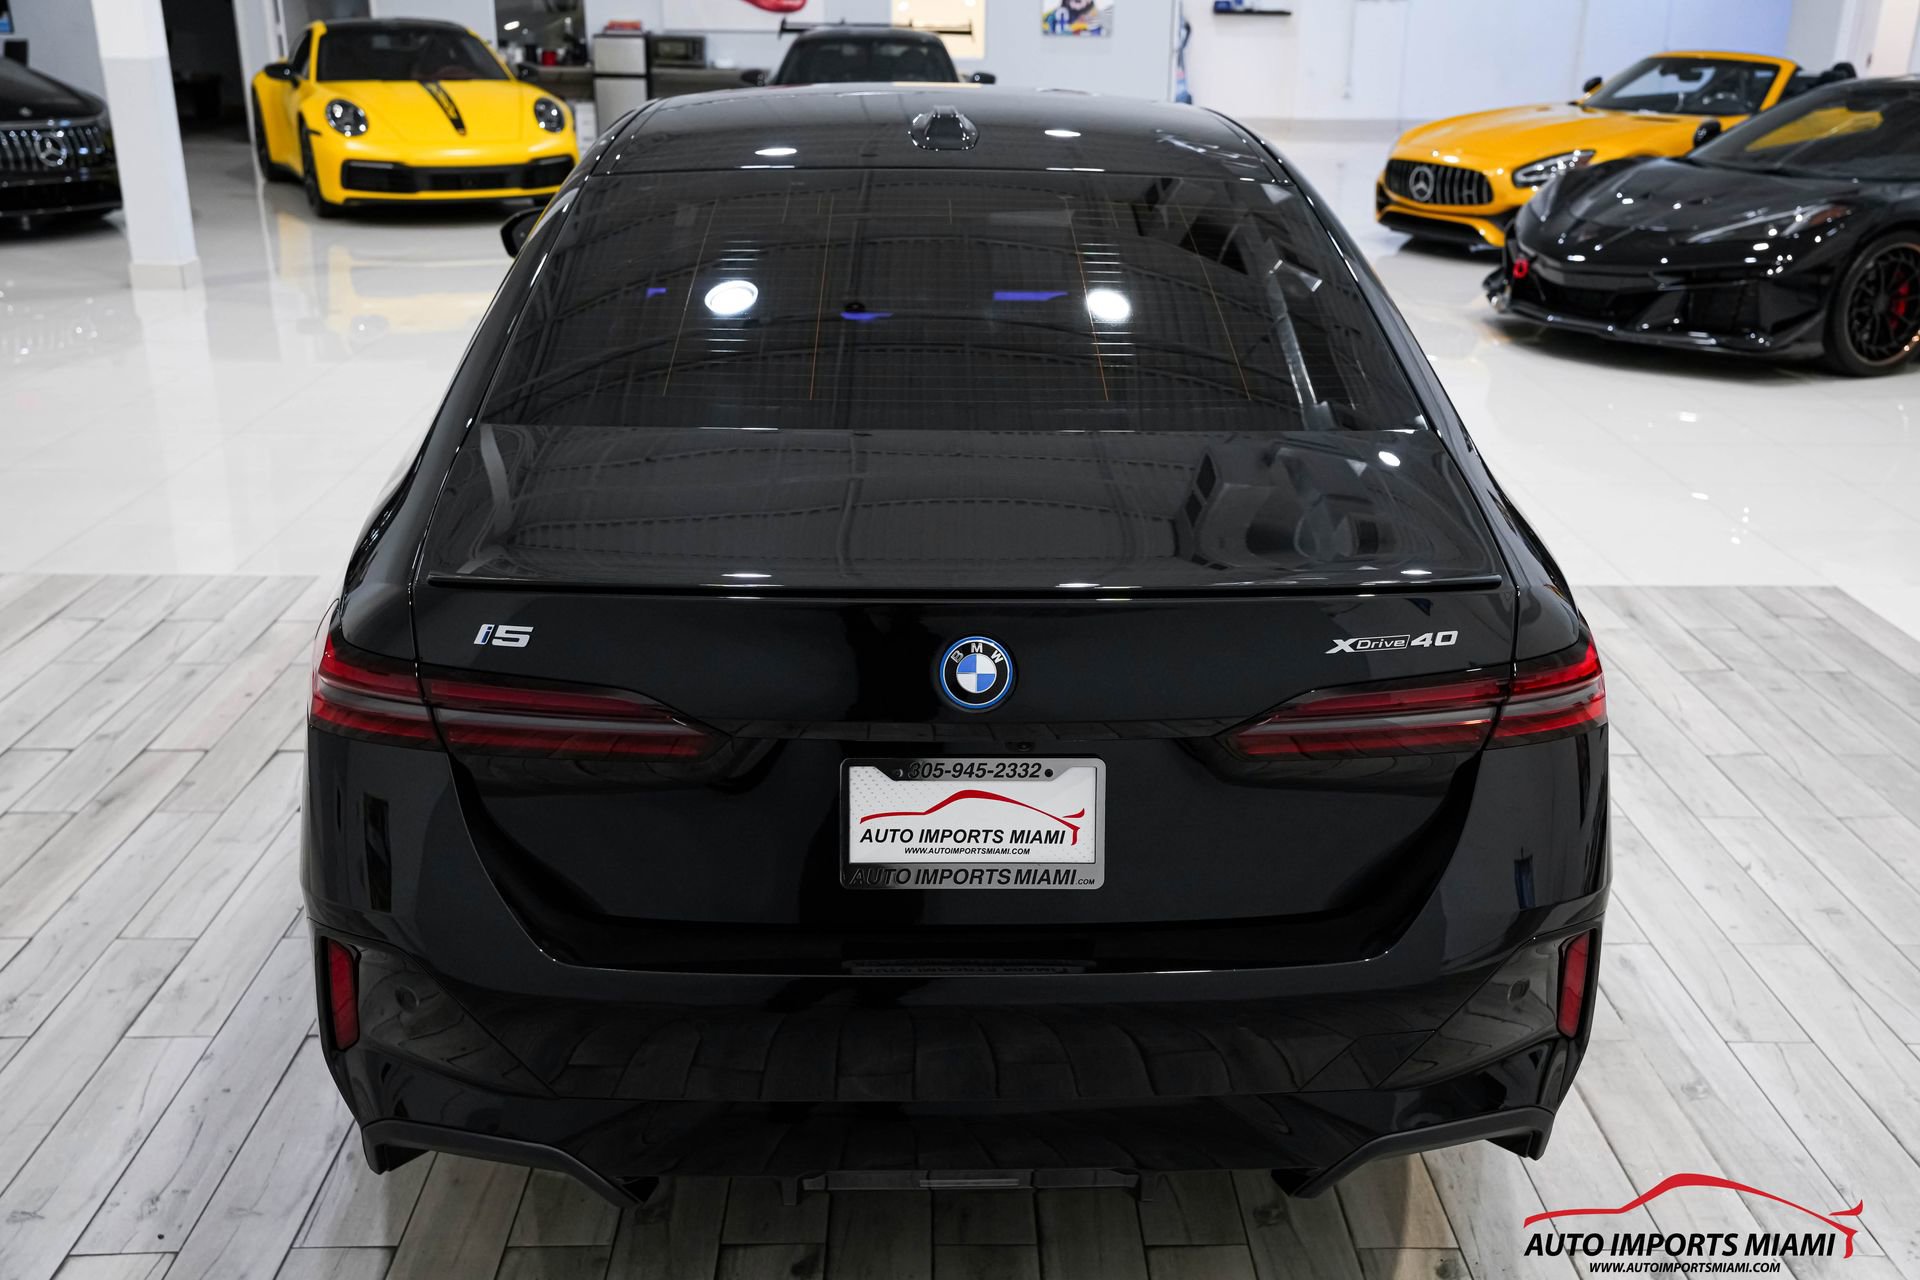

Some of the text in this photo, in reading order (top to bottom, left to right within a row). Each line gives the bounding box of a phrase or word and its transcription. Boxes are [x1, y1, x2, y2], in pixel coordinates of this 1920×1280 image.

[473, 623, 534, 648] i5
[950, 642, 1004, 664] BMW
[907, 762, 1042, 779] 305-945-2332
[859, 828, 1067, 845] AUTO IMPORTS MIAMI
[904, 847, 1031, 856] WWW.AUTOIMPORTSMIAMI.COM
[850, 868, 912, 886] AUTO
[914, 868, 1012, 886] IMPORTS
